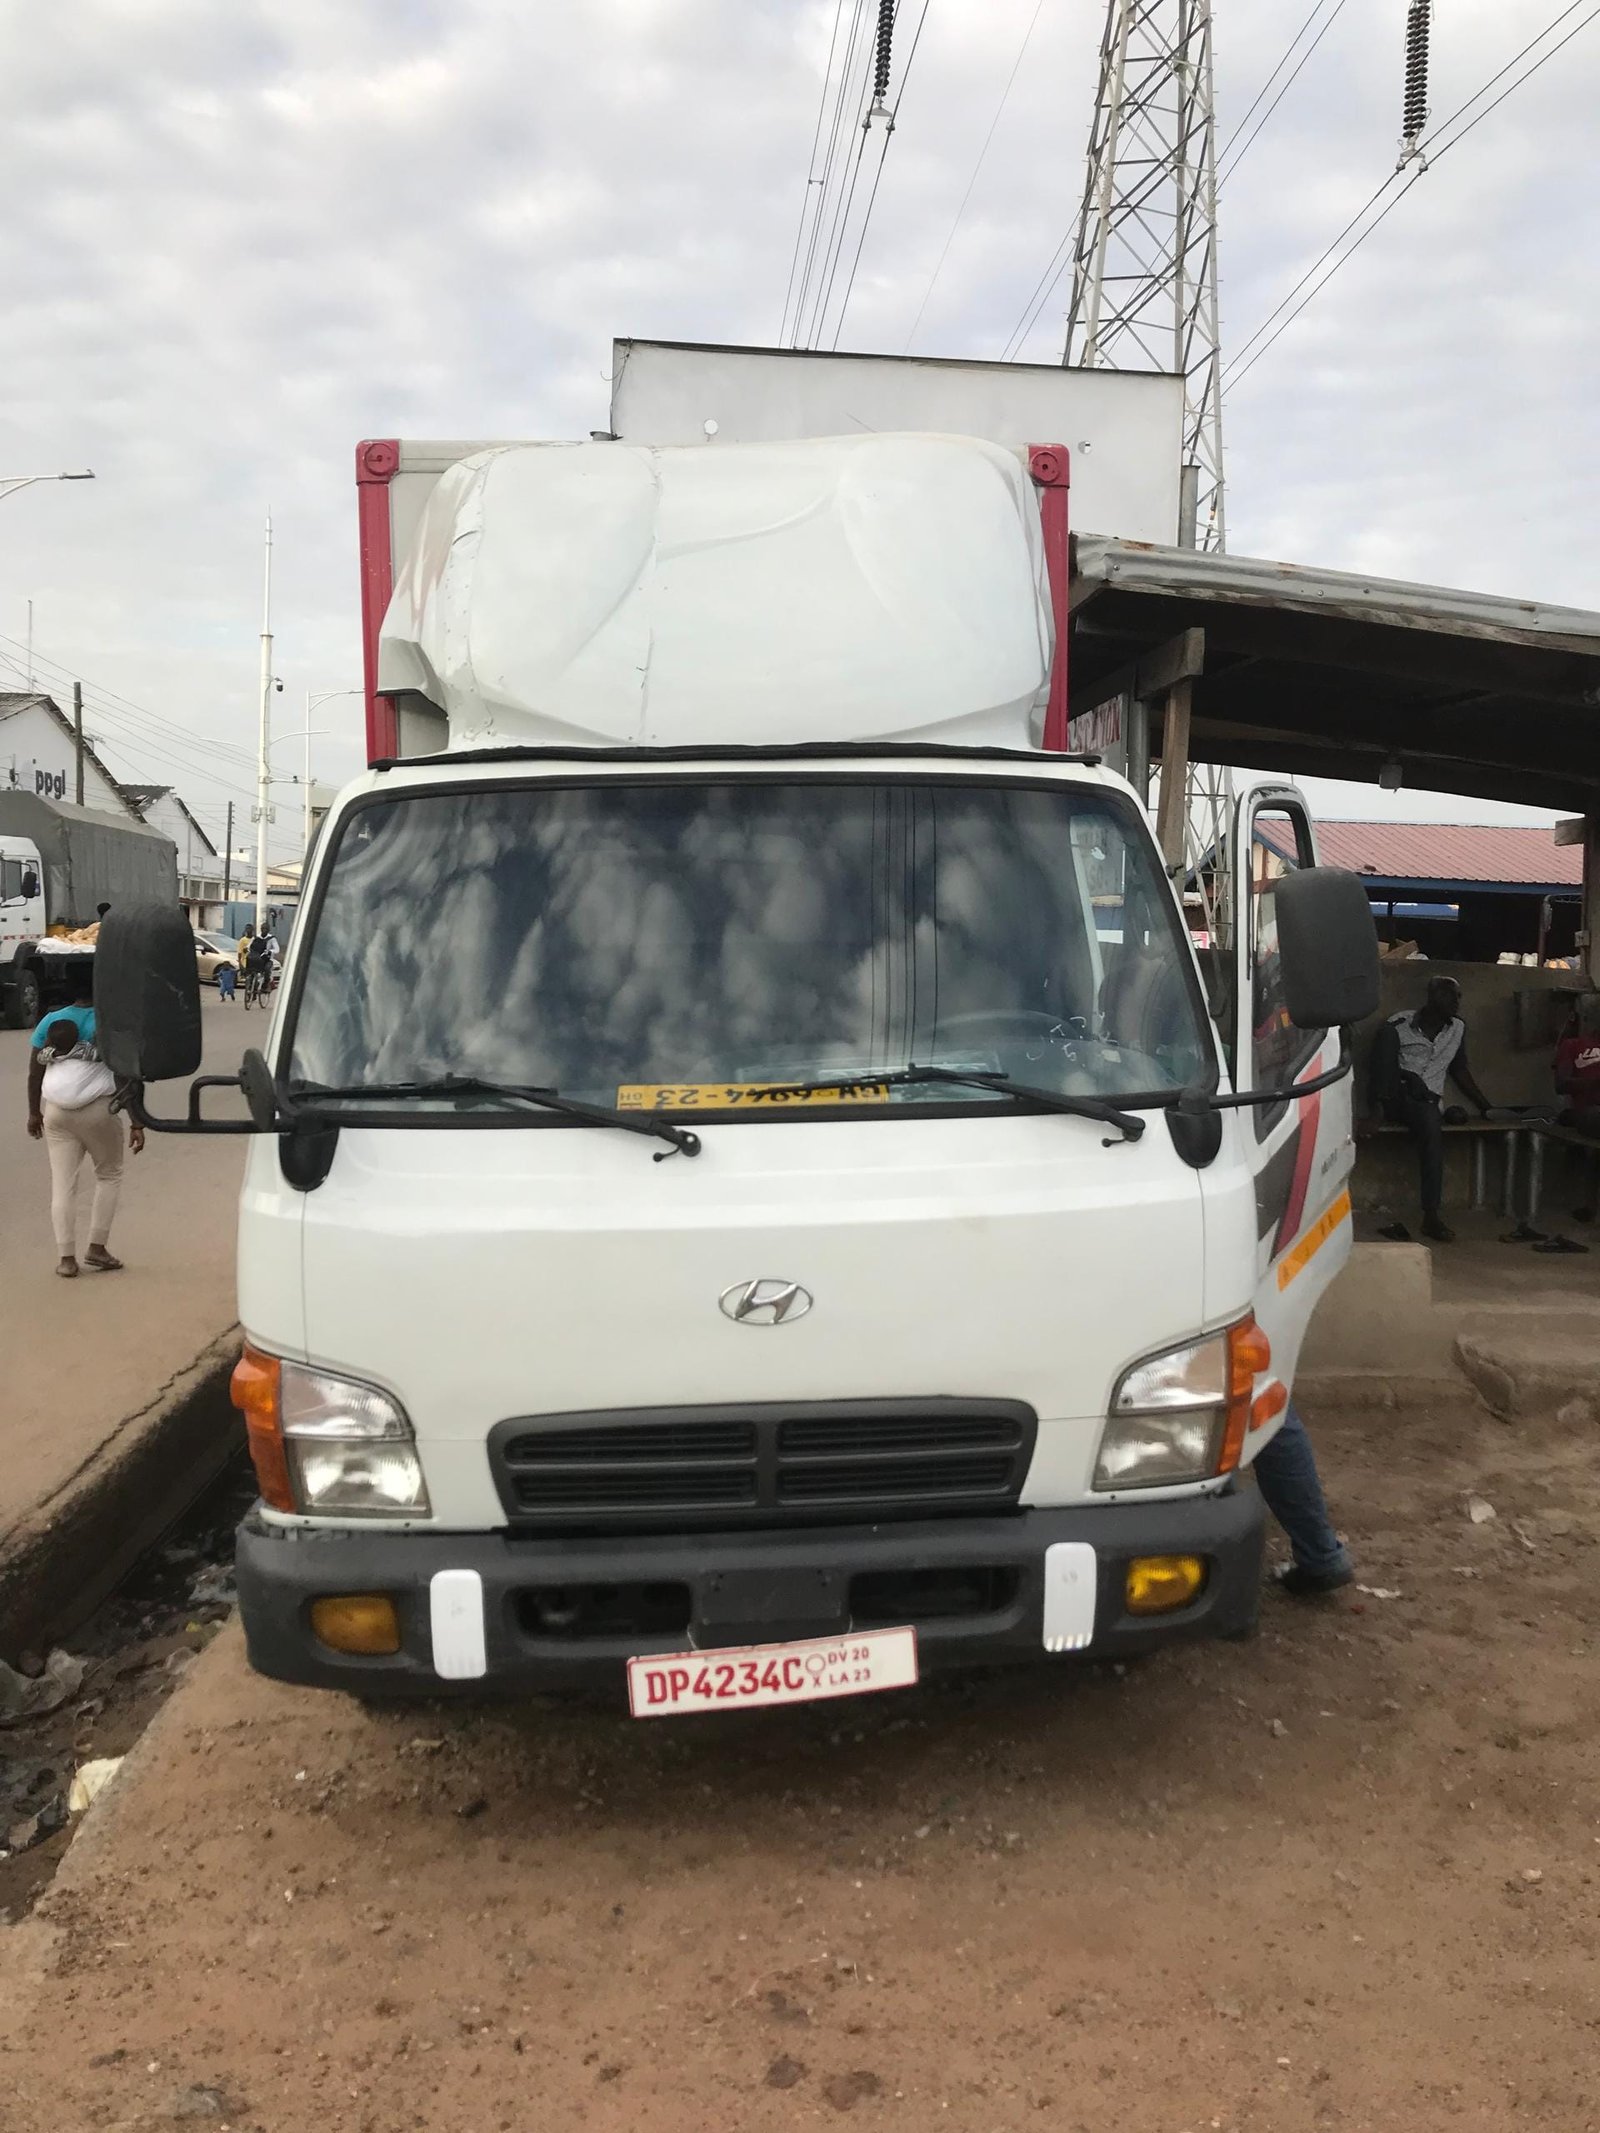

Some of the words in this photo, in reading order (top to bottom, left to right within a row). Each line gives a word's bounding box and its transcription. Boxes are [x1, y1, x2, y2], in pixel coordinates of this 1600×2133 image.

[35, 769, 65, 800] ppgl
[828, 1649, 848, 1665] DV
[853, 1647, 870, 1662] 20
[645, 1656, 805, 1706] DP4234C
[829, 1671, 849, 1686] LA
[854, 1667, 871, 1682] 23
